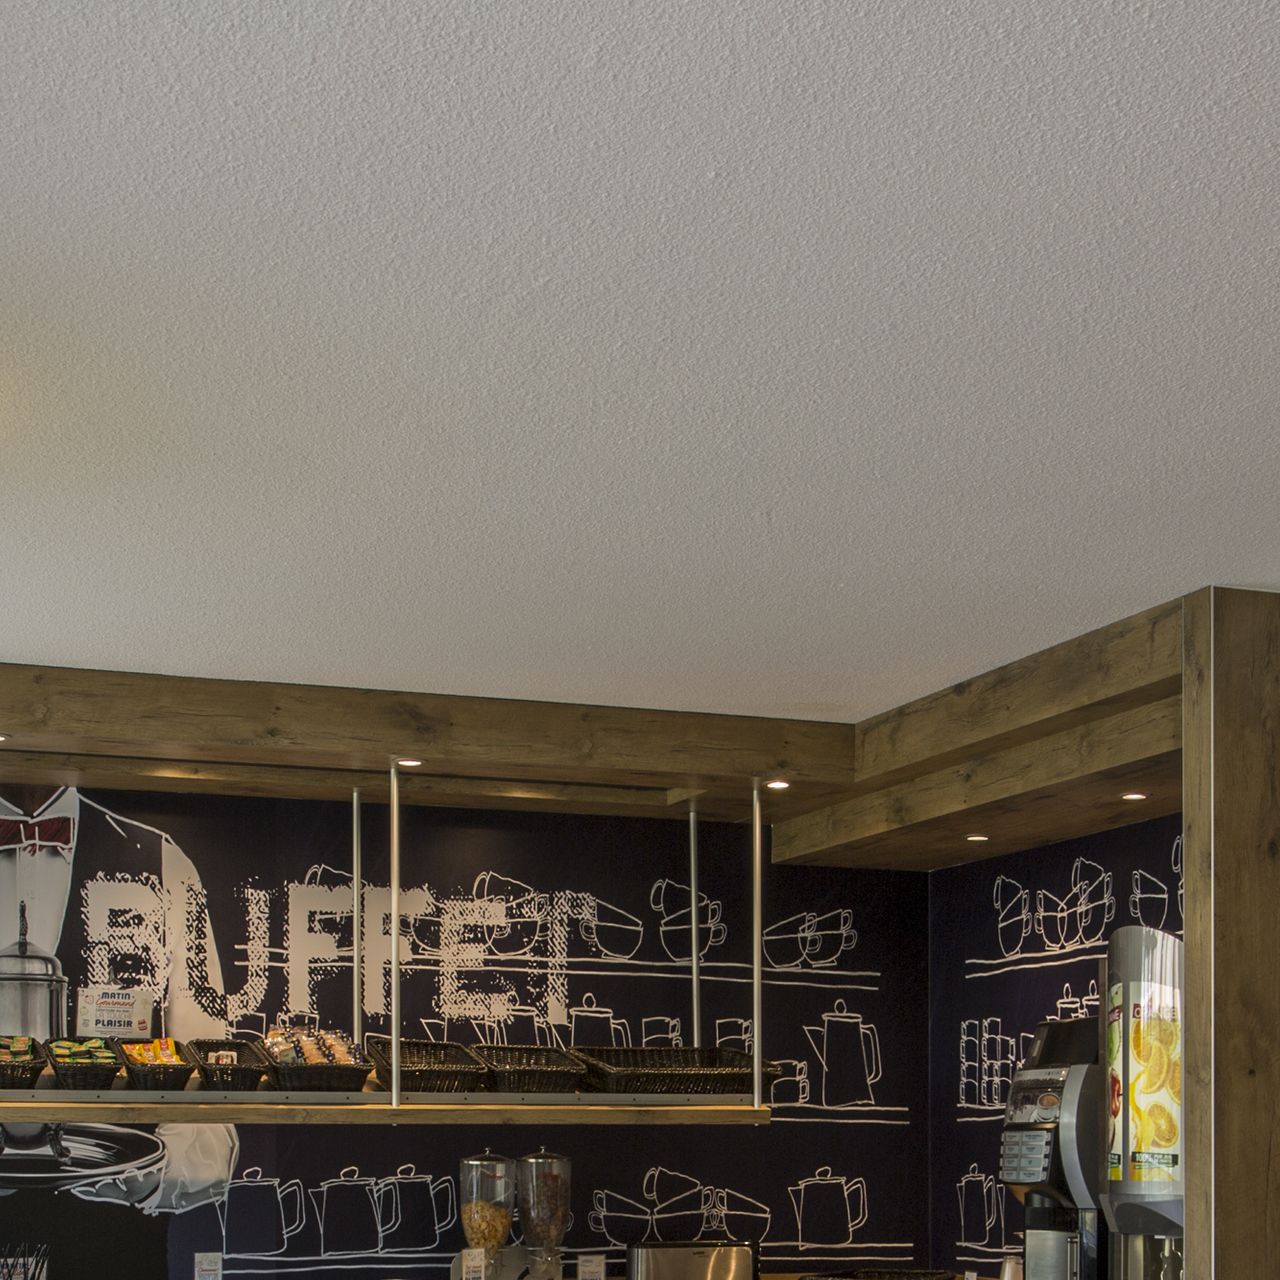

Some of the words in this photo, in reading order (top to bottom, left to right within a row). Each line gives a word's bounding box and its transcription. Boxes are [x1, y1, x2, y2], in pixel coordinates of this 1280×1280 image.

[80, 870, 597, 1026] BUFFET
[101, 992, 131, 1000] MATIN
[95, 1019, 133, 1027] PLAISIR
